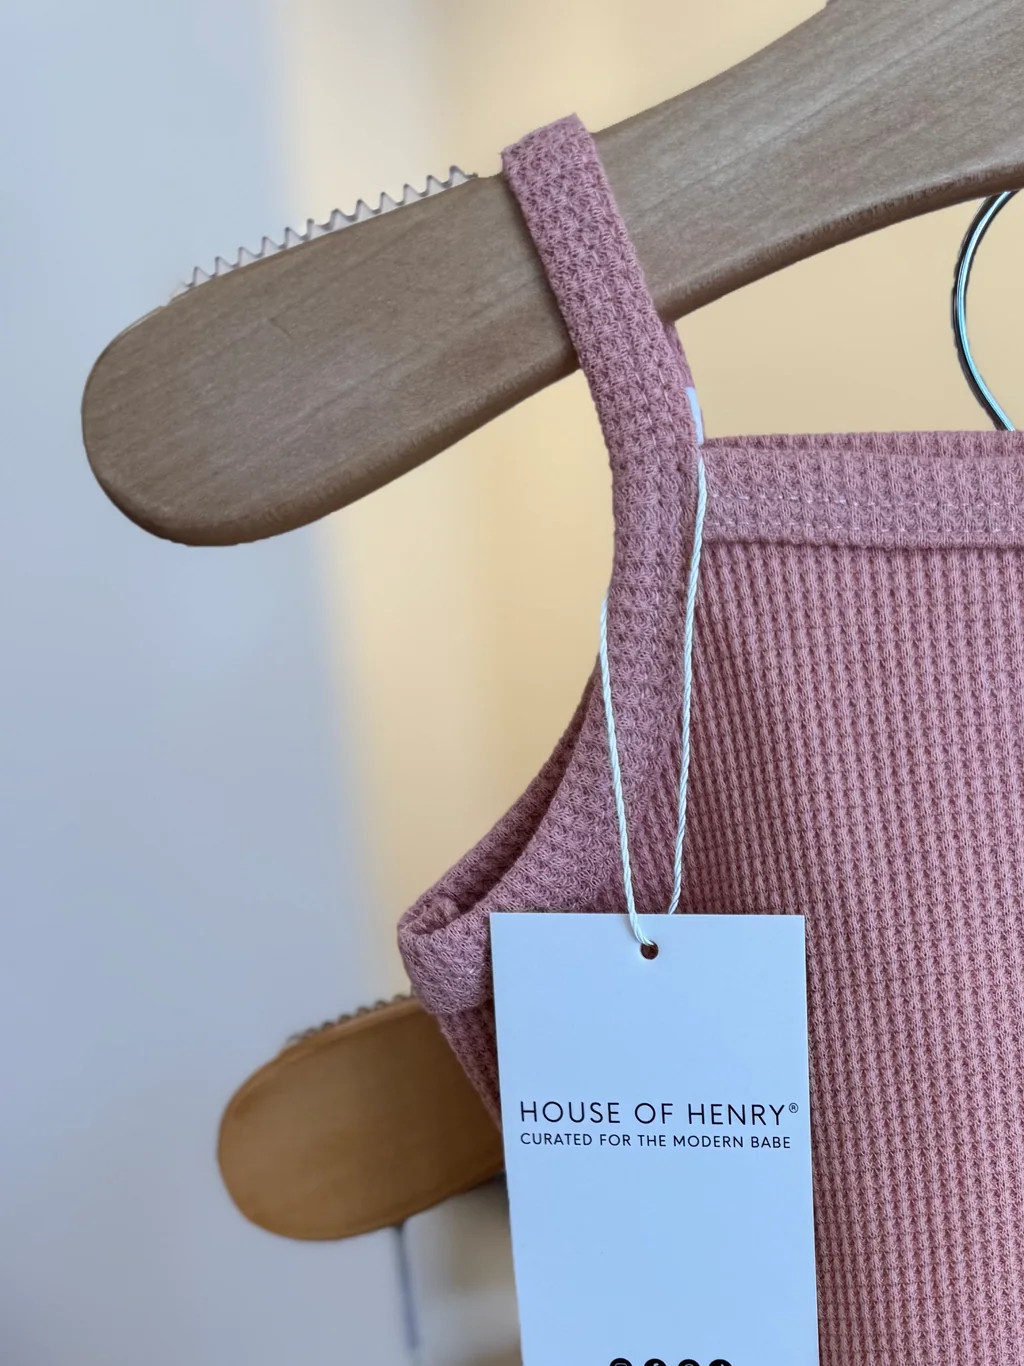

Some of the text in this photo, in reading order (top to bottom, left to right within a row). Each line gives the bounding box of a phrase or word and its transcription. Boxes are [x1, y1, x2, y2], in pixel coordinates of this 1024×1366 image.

[520, 1100, 621, 1124] HOUSE
[634, 1102, 674, 1125] OF
[520, 1132, 791, 1149] CURATED FOR THE MODERN BABE
